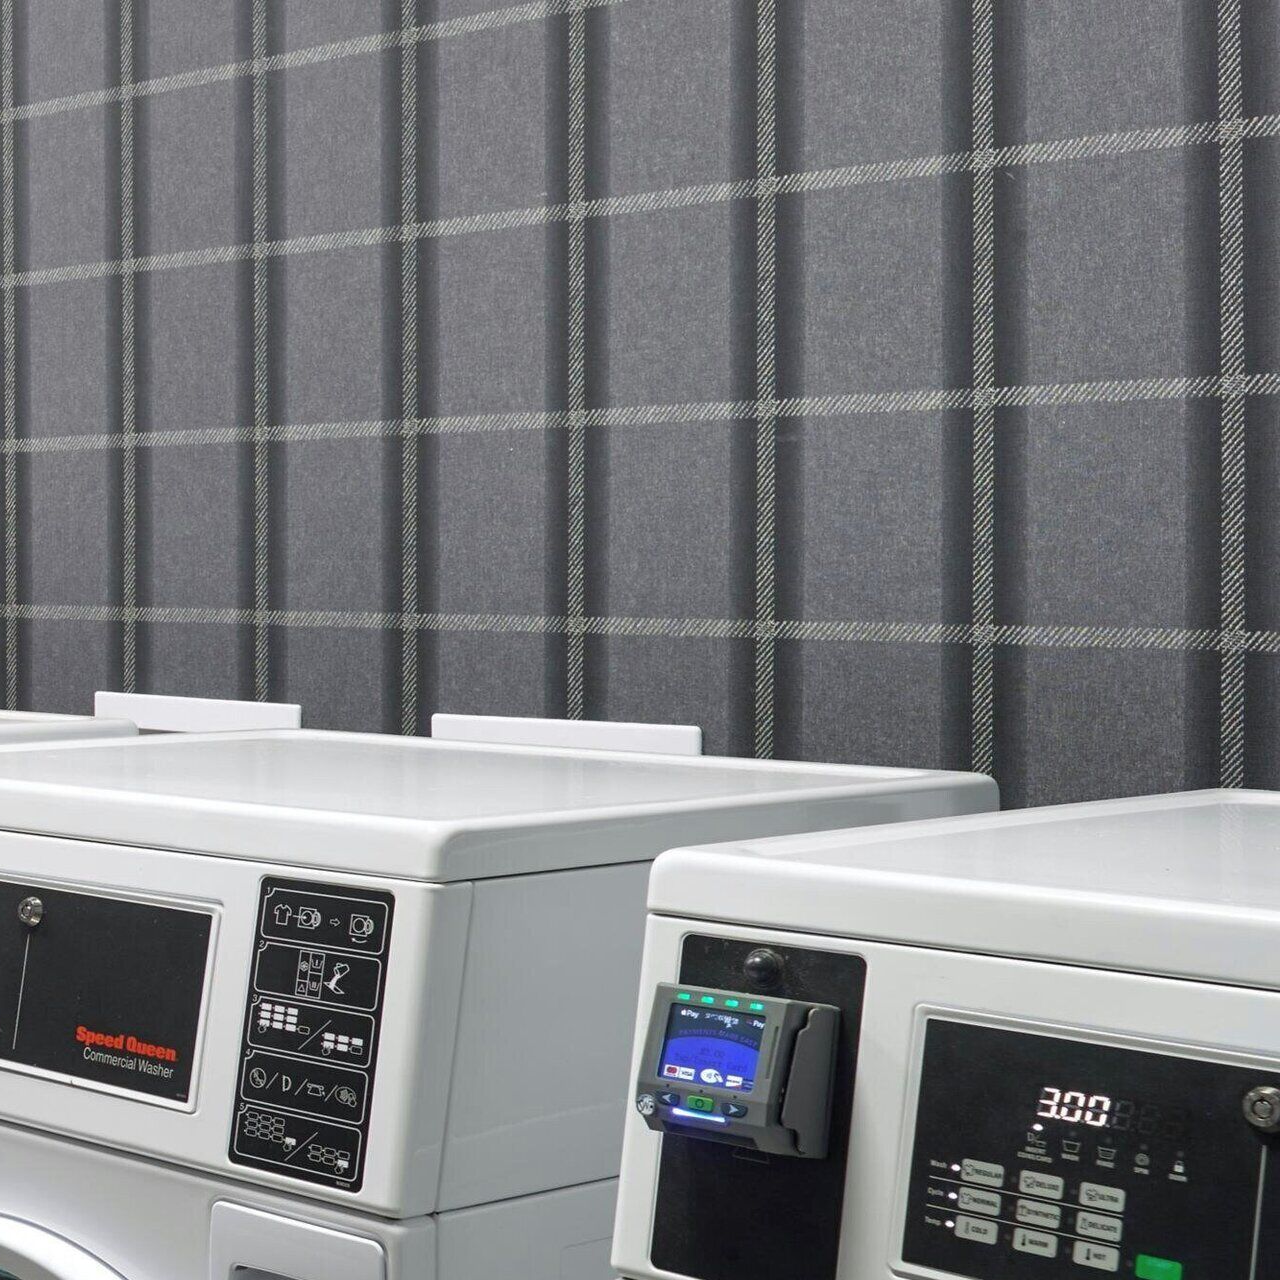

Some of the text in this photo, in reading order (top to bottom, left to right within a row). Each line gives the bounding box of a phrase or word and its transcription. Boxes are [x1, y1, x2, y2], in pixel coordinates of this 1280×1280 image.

[76, 1026, 176, 1062] Speed Queen
[83, 1046, 174, 1078] Commercial Washer
[1036, 1086, 1112, 1127] 3.00
